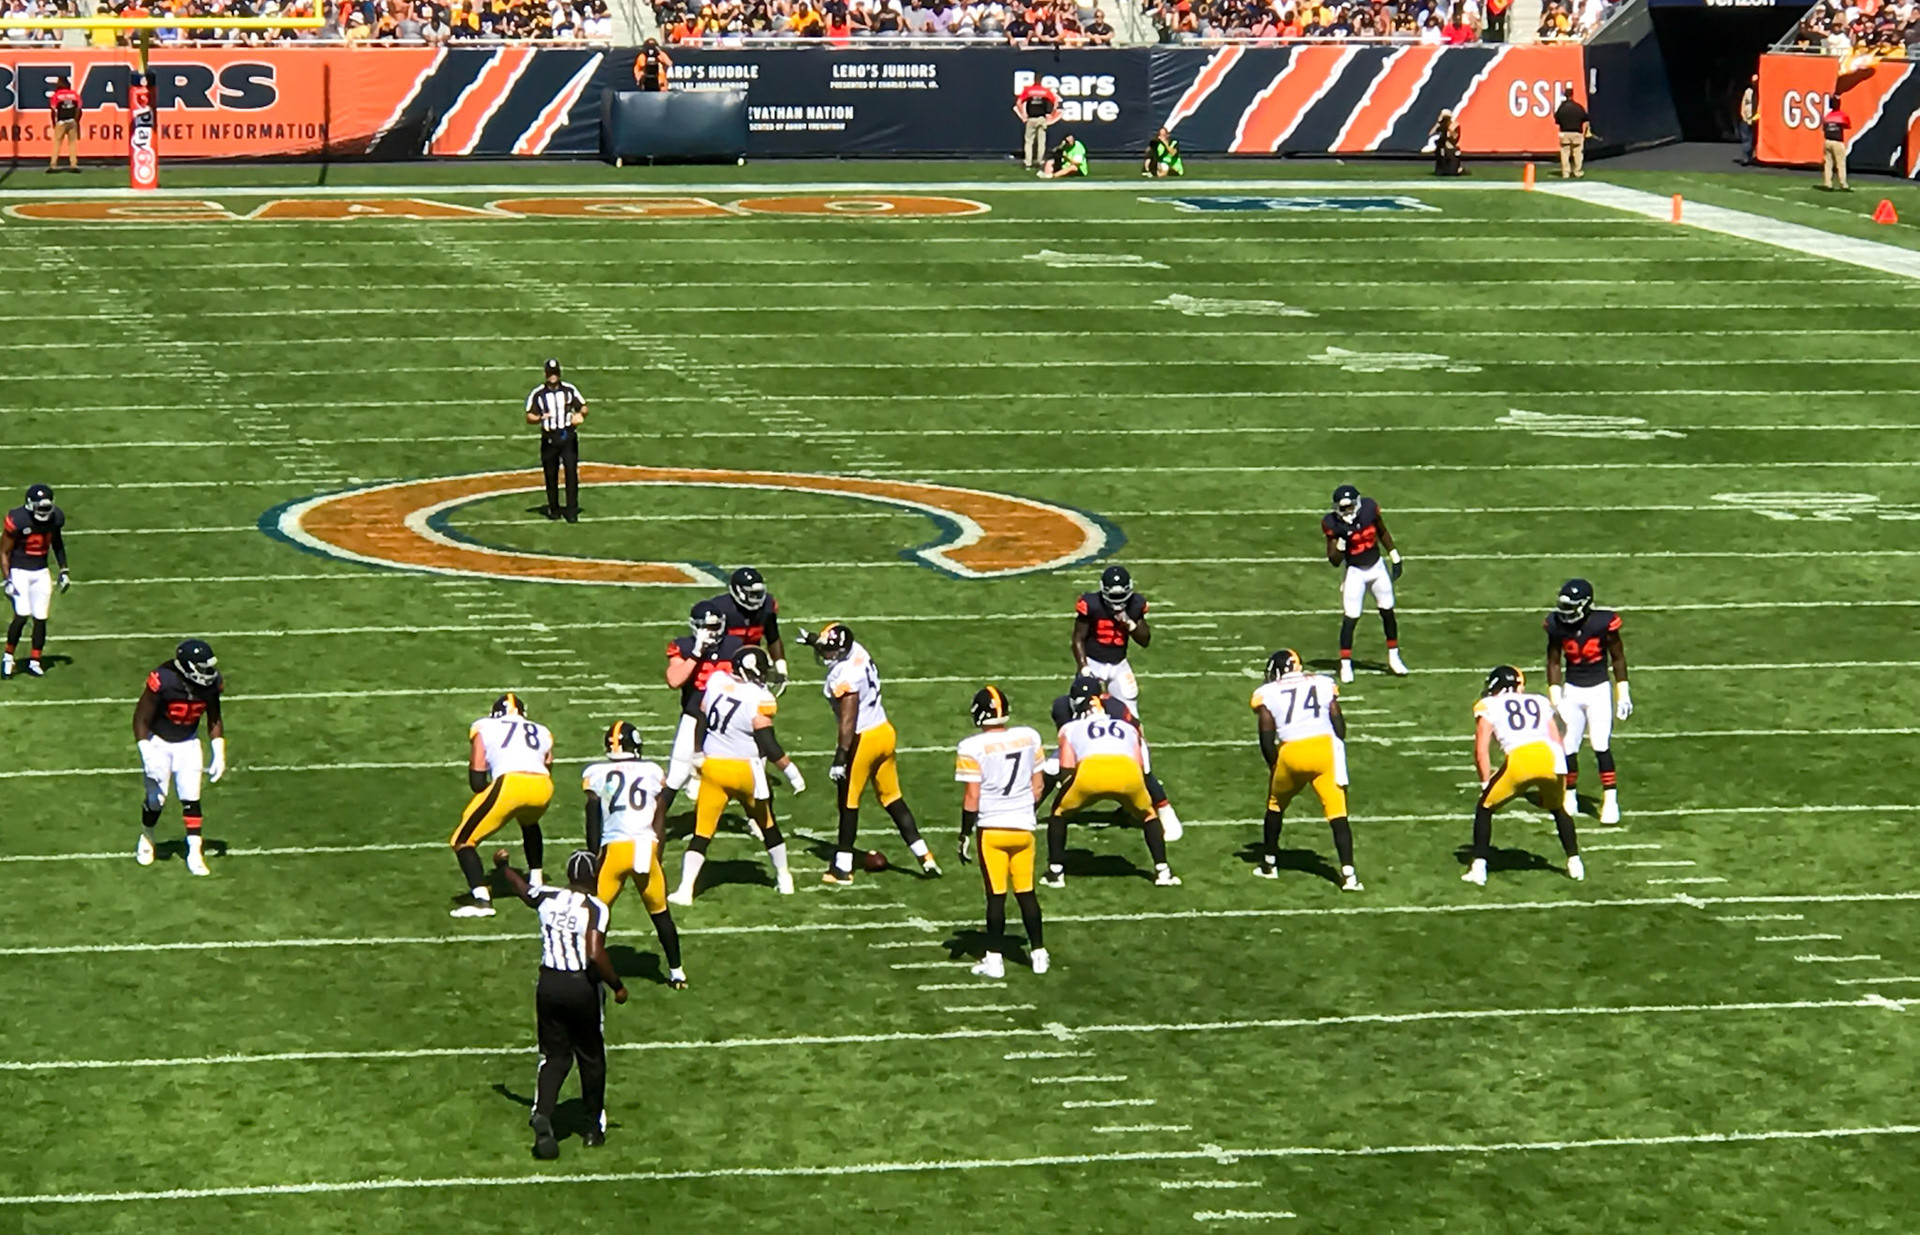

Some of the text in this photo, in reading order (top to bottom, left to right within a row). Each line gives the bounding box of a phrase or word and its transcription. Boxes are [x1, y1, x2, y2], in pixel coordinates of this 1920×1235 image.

[0, 61, 278, 112] EARS
[666, 65, 759, 79] ARD'S HUDDLE
[833, 64, 937, 78] LENO'S JUNIORS
[748, 106, 854, 120] VATHAN NATION
[1061, 100, 1120, 122] are
[89, 125, 124, 140] FOR
[161, 124, 195, 139] KET
[202, 123, 330, 139] INFORMATION
[707, 693, 743, 735] 67
[1280, 684, 1322, 725] 74
[1504, 698, 1541, 731] 89
[500, 720, 541, 751] 78
[1087, 721, 1125, 741] 66
[1001, 751, 1022, 796] 7
[605, 769, 648, 815] 26
